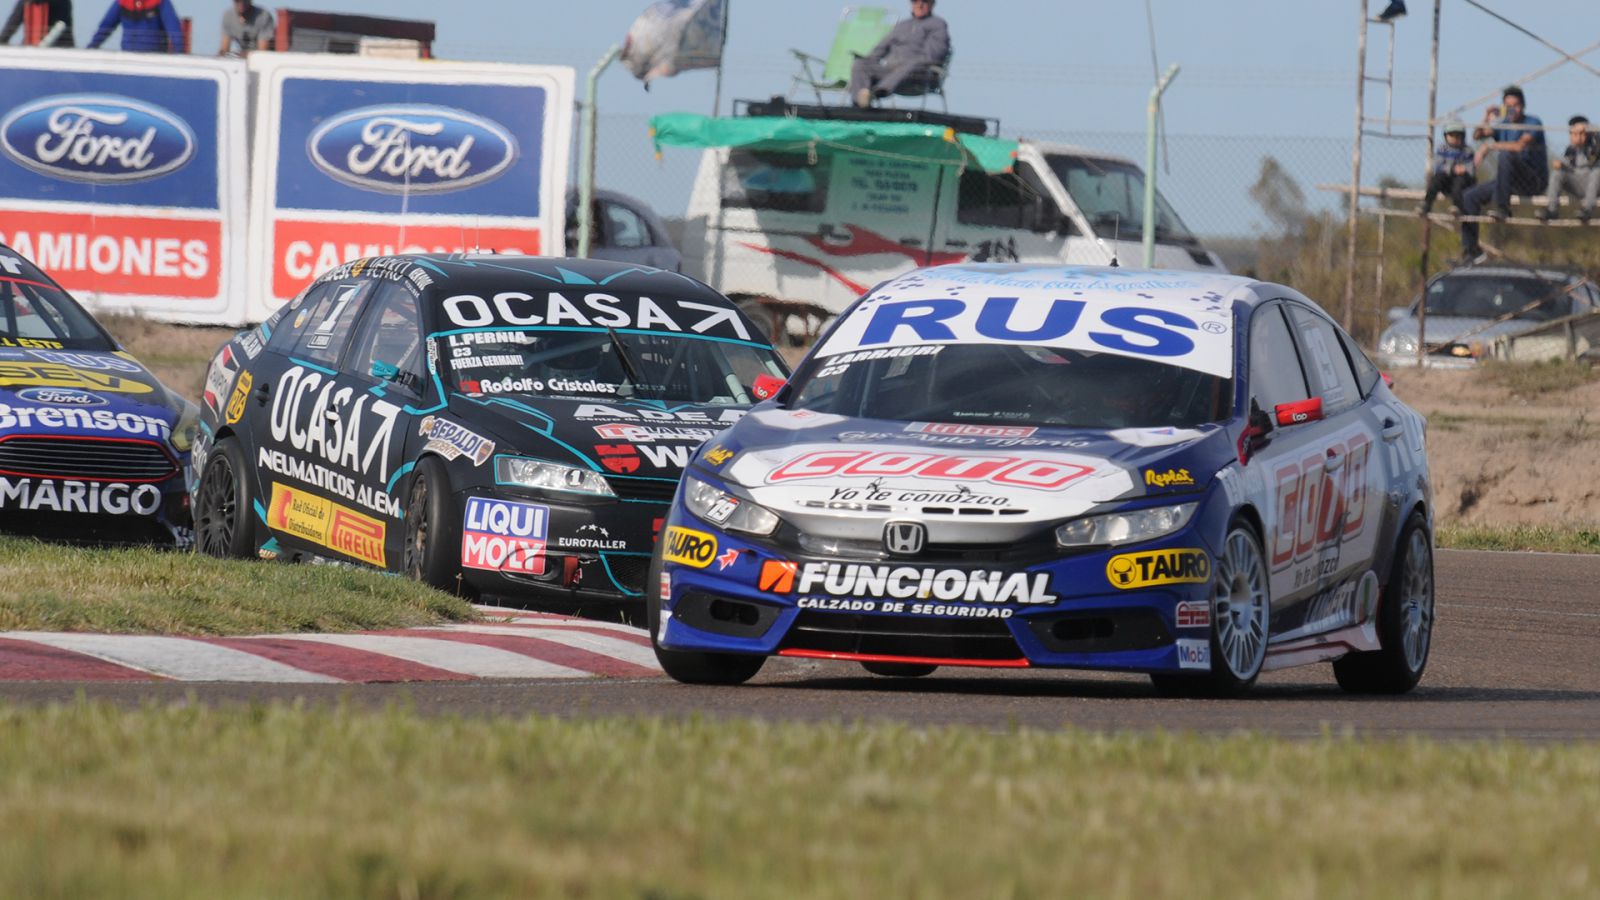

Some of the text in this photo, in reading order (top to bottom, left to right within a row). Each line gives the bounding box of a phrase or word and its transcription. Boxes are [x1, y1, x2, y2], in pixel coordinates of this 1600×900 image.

[36, 107, 159, 169] Ford
[348, 117, 475, 178] Ford
[0, 231, 208, 278] AMIONES
[443, 292, 683, 331] OCASA
[859, 297, 1199, 357] RUS
[450, 356, 483, 370] FUERZA
[453, 347, 472, 358] C3
[817, 364, 850, 378] C3
[37, 390, 92, 404] Ford
[480, 378, 616, 393] Rodolfo Cristales
[271, 366, 369, 472] OCASA
[258, 446, 356, 500] NEUMATICOS
[356, 484, 400, 518] ALEM
[569, 470, 582, 486] 1
[830, 488, 859, 500] Yo
[332, 509, 384, 563] PIRELLI
[466, 500, 544, 538] LIQUI
[464, 534, 543, 571] MOLY
[558, 538, 627, 550] EUROTALLER
[798, 562, 1058, 605] FUNCIONAL
[1136, 552, 1209, 581] TAURO
[797, 598, 1014, 619] CALZADO DE SEGURIDAD
